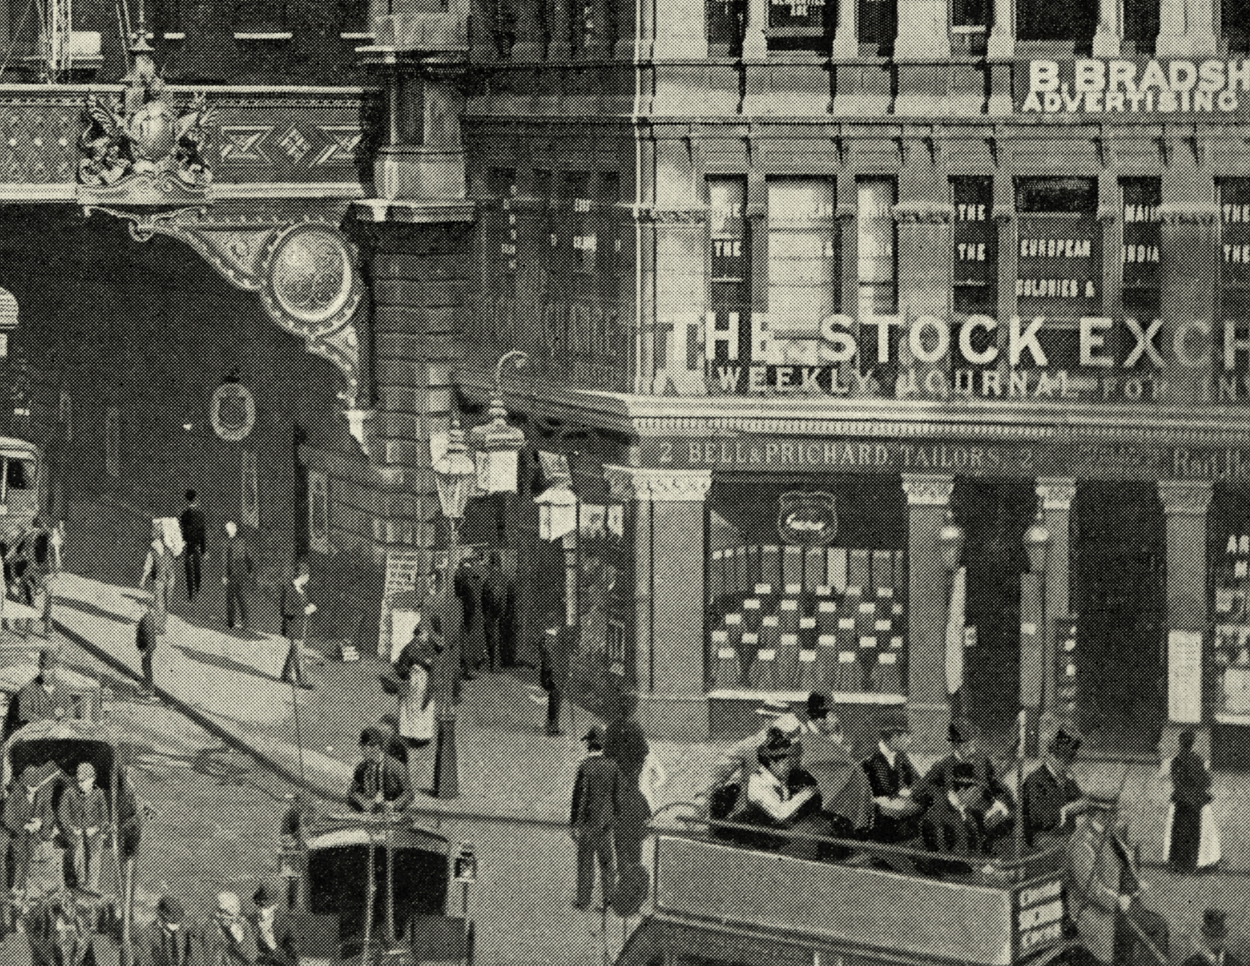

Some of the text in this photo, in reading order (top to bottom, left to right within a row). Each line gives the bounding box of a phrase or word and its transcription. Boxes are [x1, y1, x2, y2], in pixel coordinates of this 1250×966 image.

[1075, 59, 1250, 92] BRADSH
[1022, 92, 1239, 113] ADVERTISING
[958, 204, 986, 221] THE
[714, 241, 741, 257] THE
[958, 243, 986, 261] THE
[1020, 239, 1091, 257] EUROPEAN
[1121, 245, 1160, 263] INDIA
[1015, 278, 1079, 297] COLONIES
[661, 311, 772, 362] THE
[820, 314, 1049, 367] STOCK
[1079, 317, 1250, 370] EXCH
[717, 367, 874, 395] WEEKLY
[898, 369, 1082, 398] JOURNAL
[1102, 375, 1168, 401] FOR
[1200, 377, 1250, 401] IN
[658, 444, 673, 464] 2
